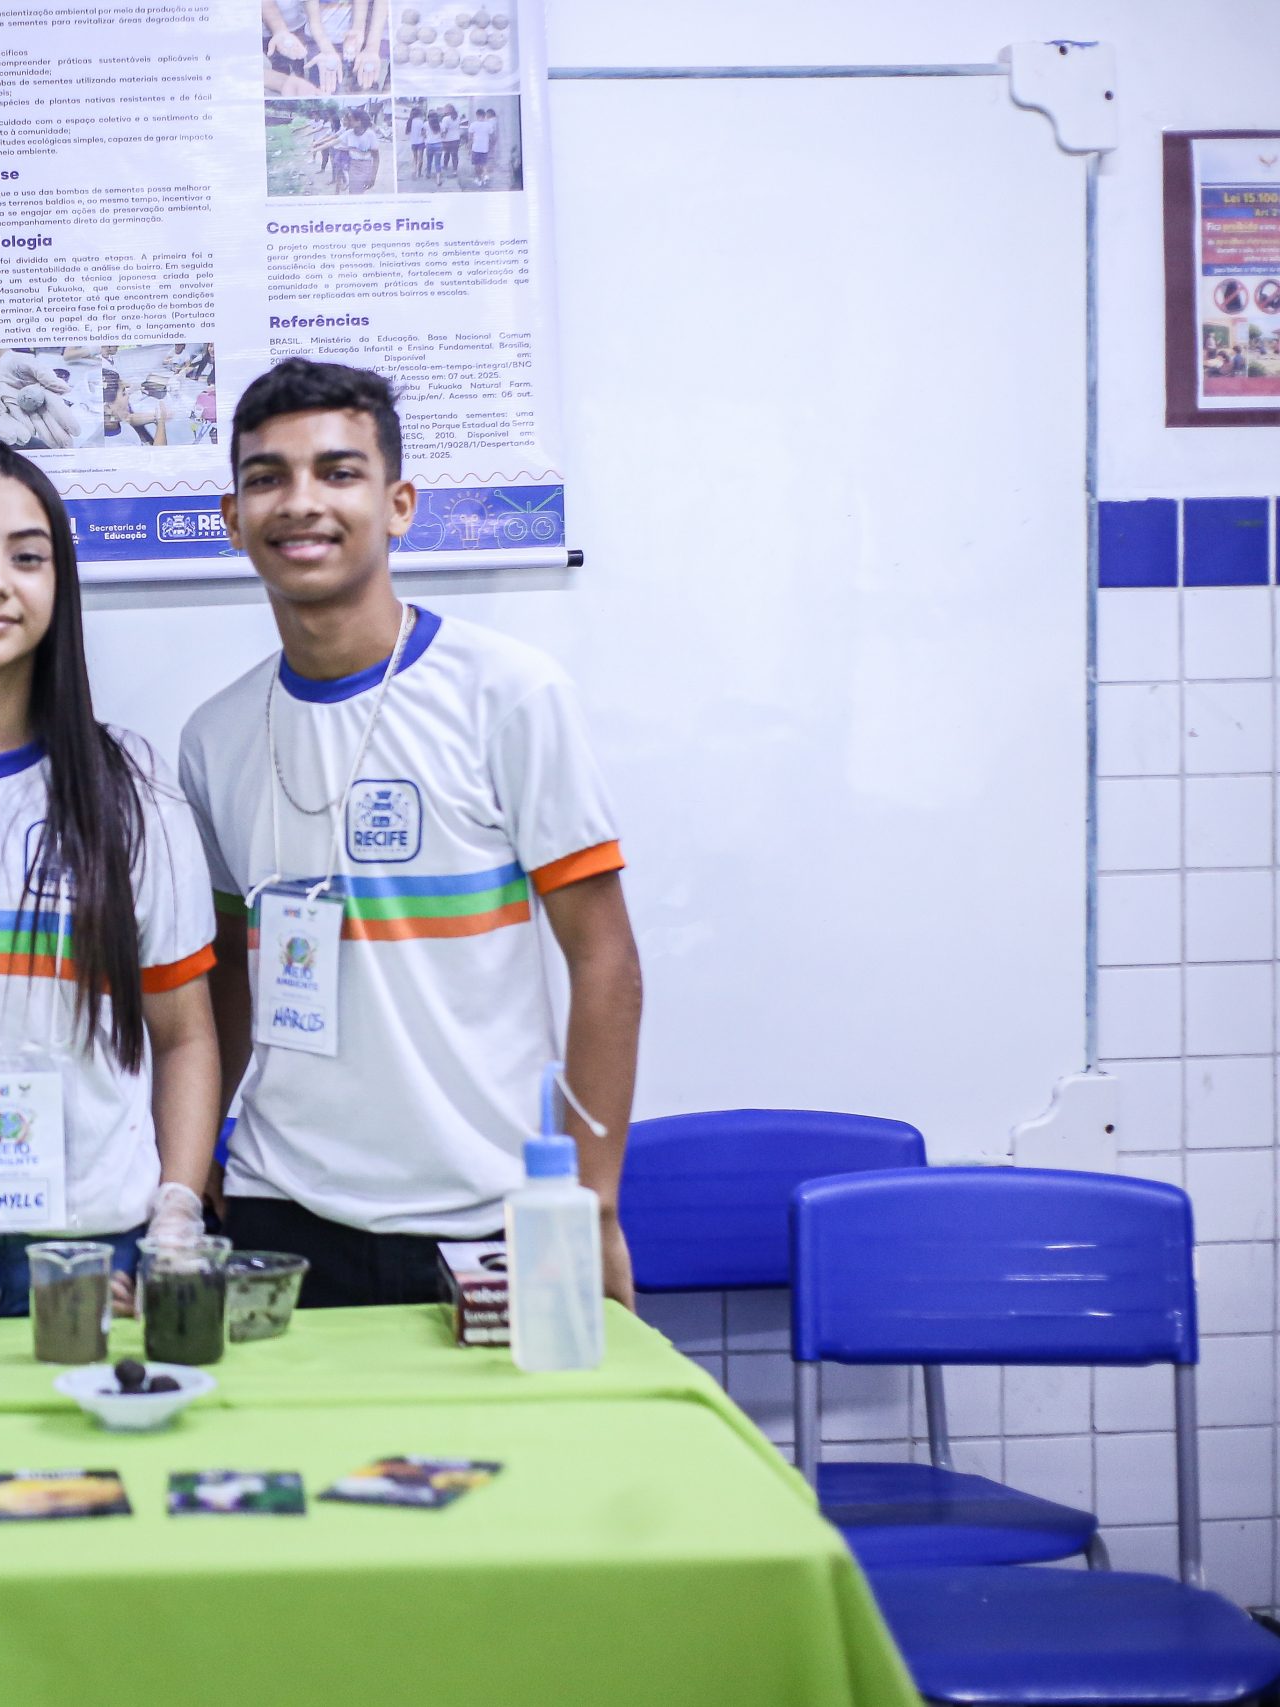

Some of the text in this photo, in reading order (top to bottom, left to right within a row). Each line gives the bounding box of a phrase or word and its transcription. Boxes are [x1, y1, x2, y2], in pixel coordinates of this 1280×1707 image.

[266, 218, 444, 235] Considerações Finais
[270, 314, 370, 328] Referências
[269, 335, 302, 344] BRASIL.
[310, 334, 351, 343] Ministério
[377, 332, 419, 343] Educação.
[455, 330, 491, 340] Nacional
[498, 330, 531, 339] Comum
[104, 532, 146, 540] Educação
[354, 831, 408, 846] RECIFE
